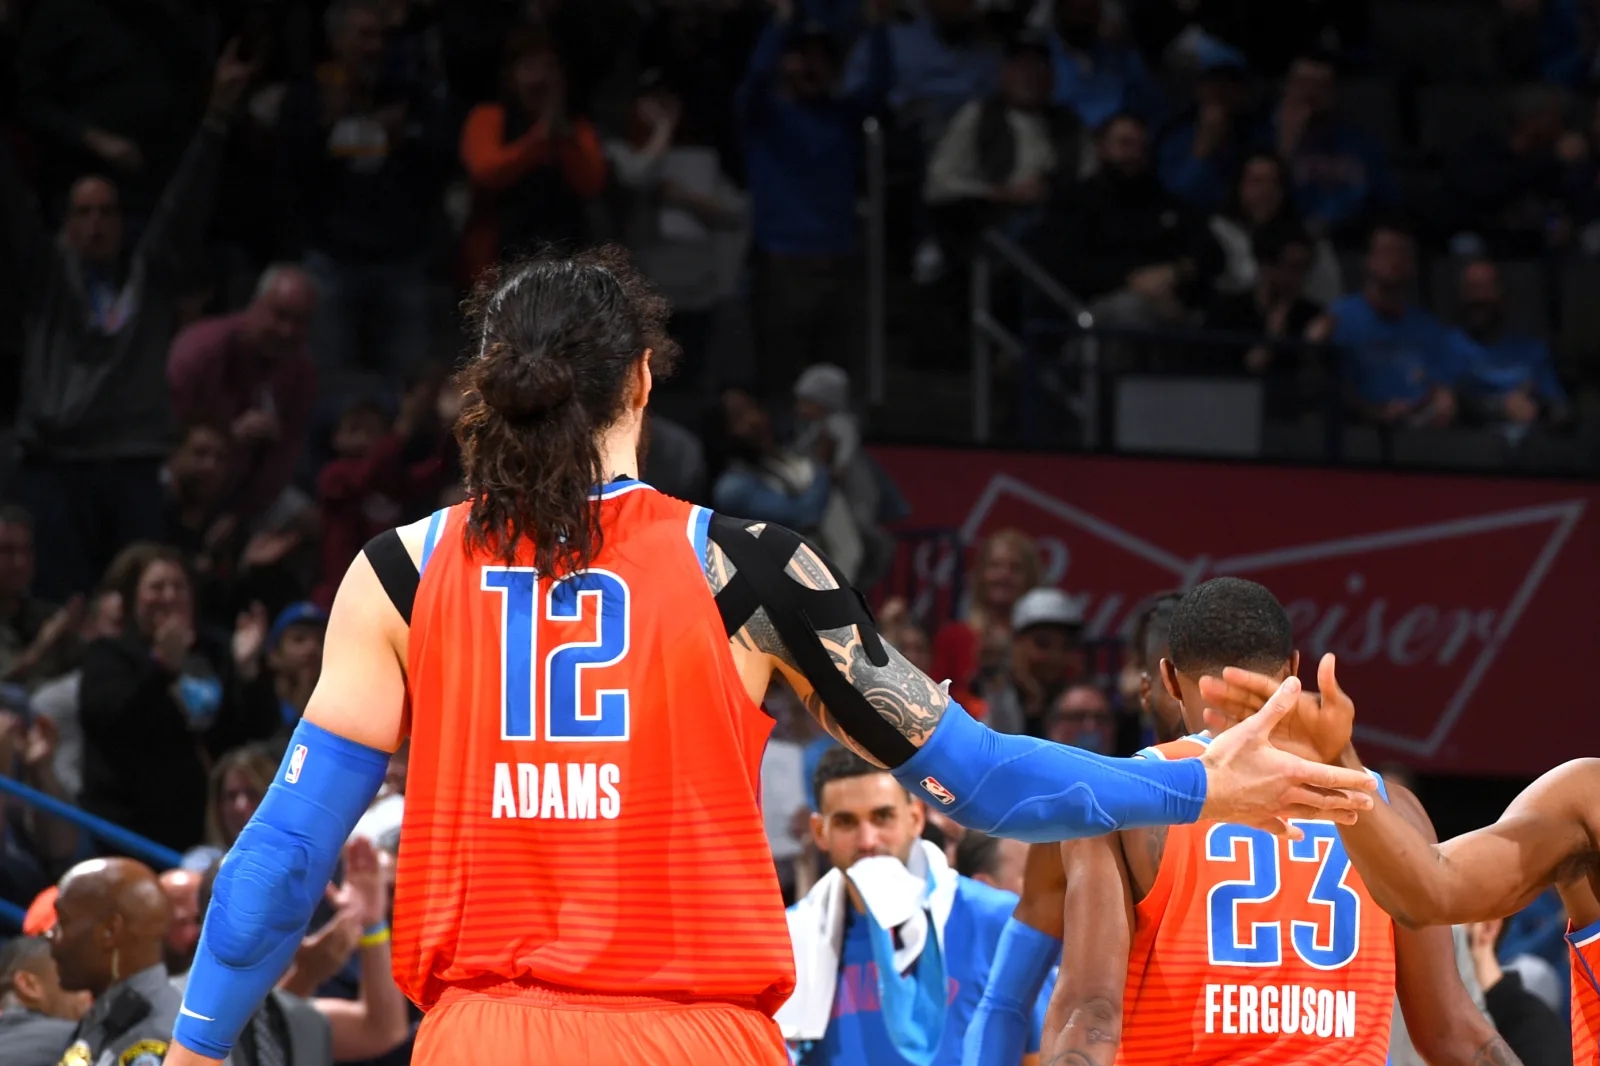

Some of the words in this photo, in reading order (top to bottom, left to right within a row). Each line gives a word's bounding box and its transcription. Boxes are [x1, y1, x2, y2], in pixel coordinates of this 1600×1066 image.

[479, 566, 631, 742] 12
[491, 762, 621, 820] ADAMS
[1205, 817, 1361, 970] 23
[1205, 984, 1356, 1038] FERGUSON
